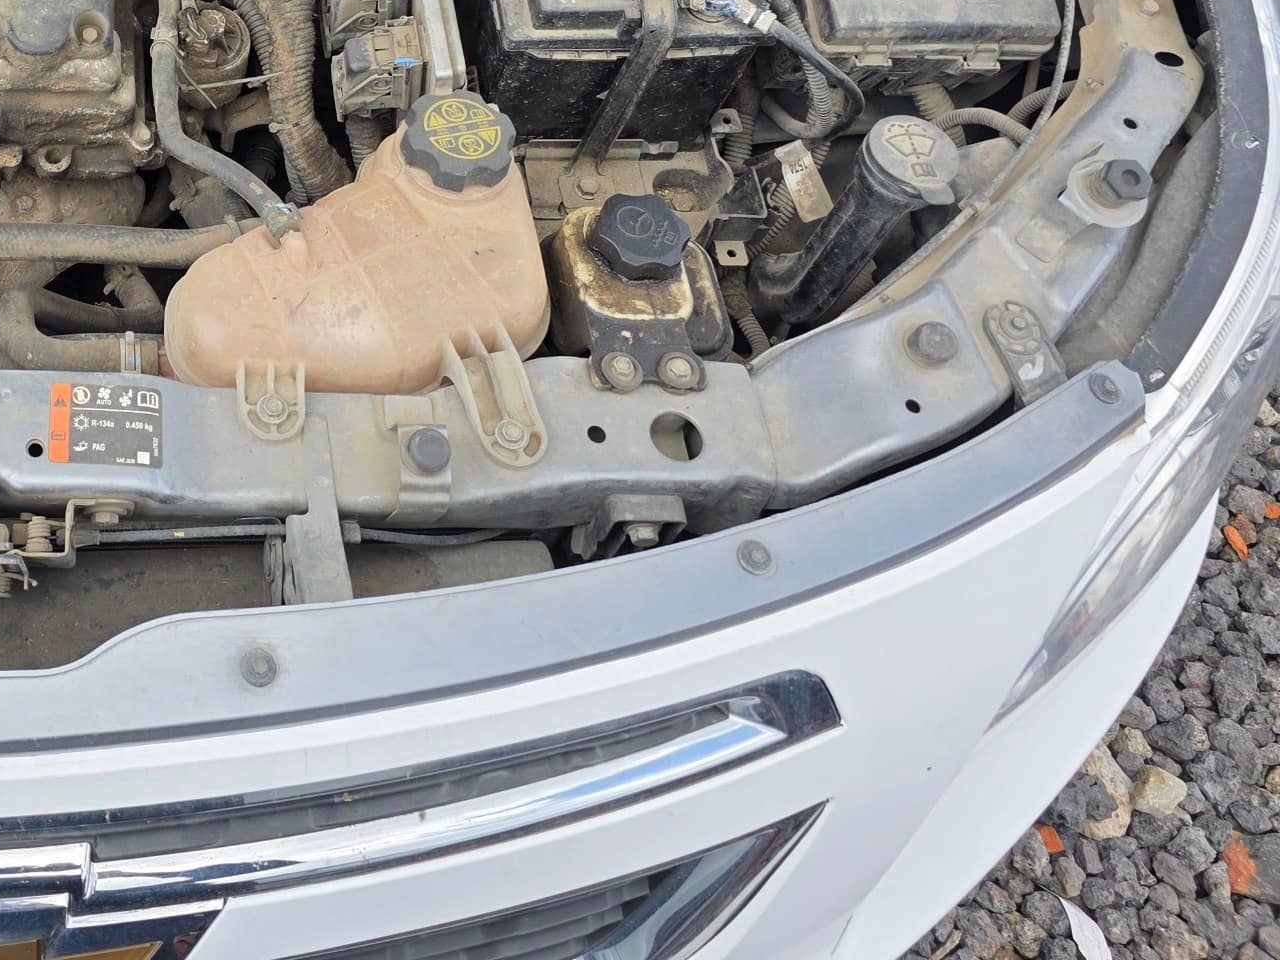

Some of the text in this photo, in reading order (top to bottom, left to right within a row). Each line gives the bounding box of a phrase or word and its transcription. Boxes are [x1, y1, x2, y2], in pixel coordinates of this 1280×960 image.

[91, 419, 153, 433] R-134a 0.450 kg
[92, 442, 106, 451] PAG
